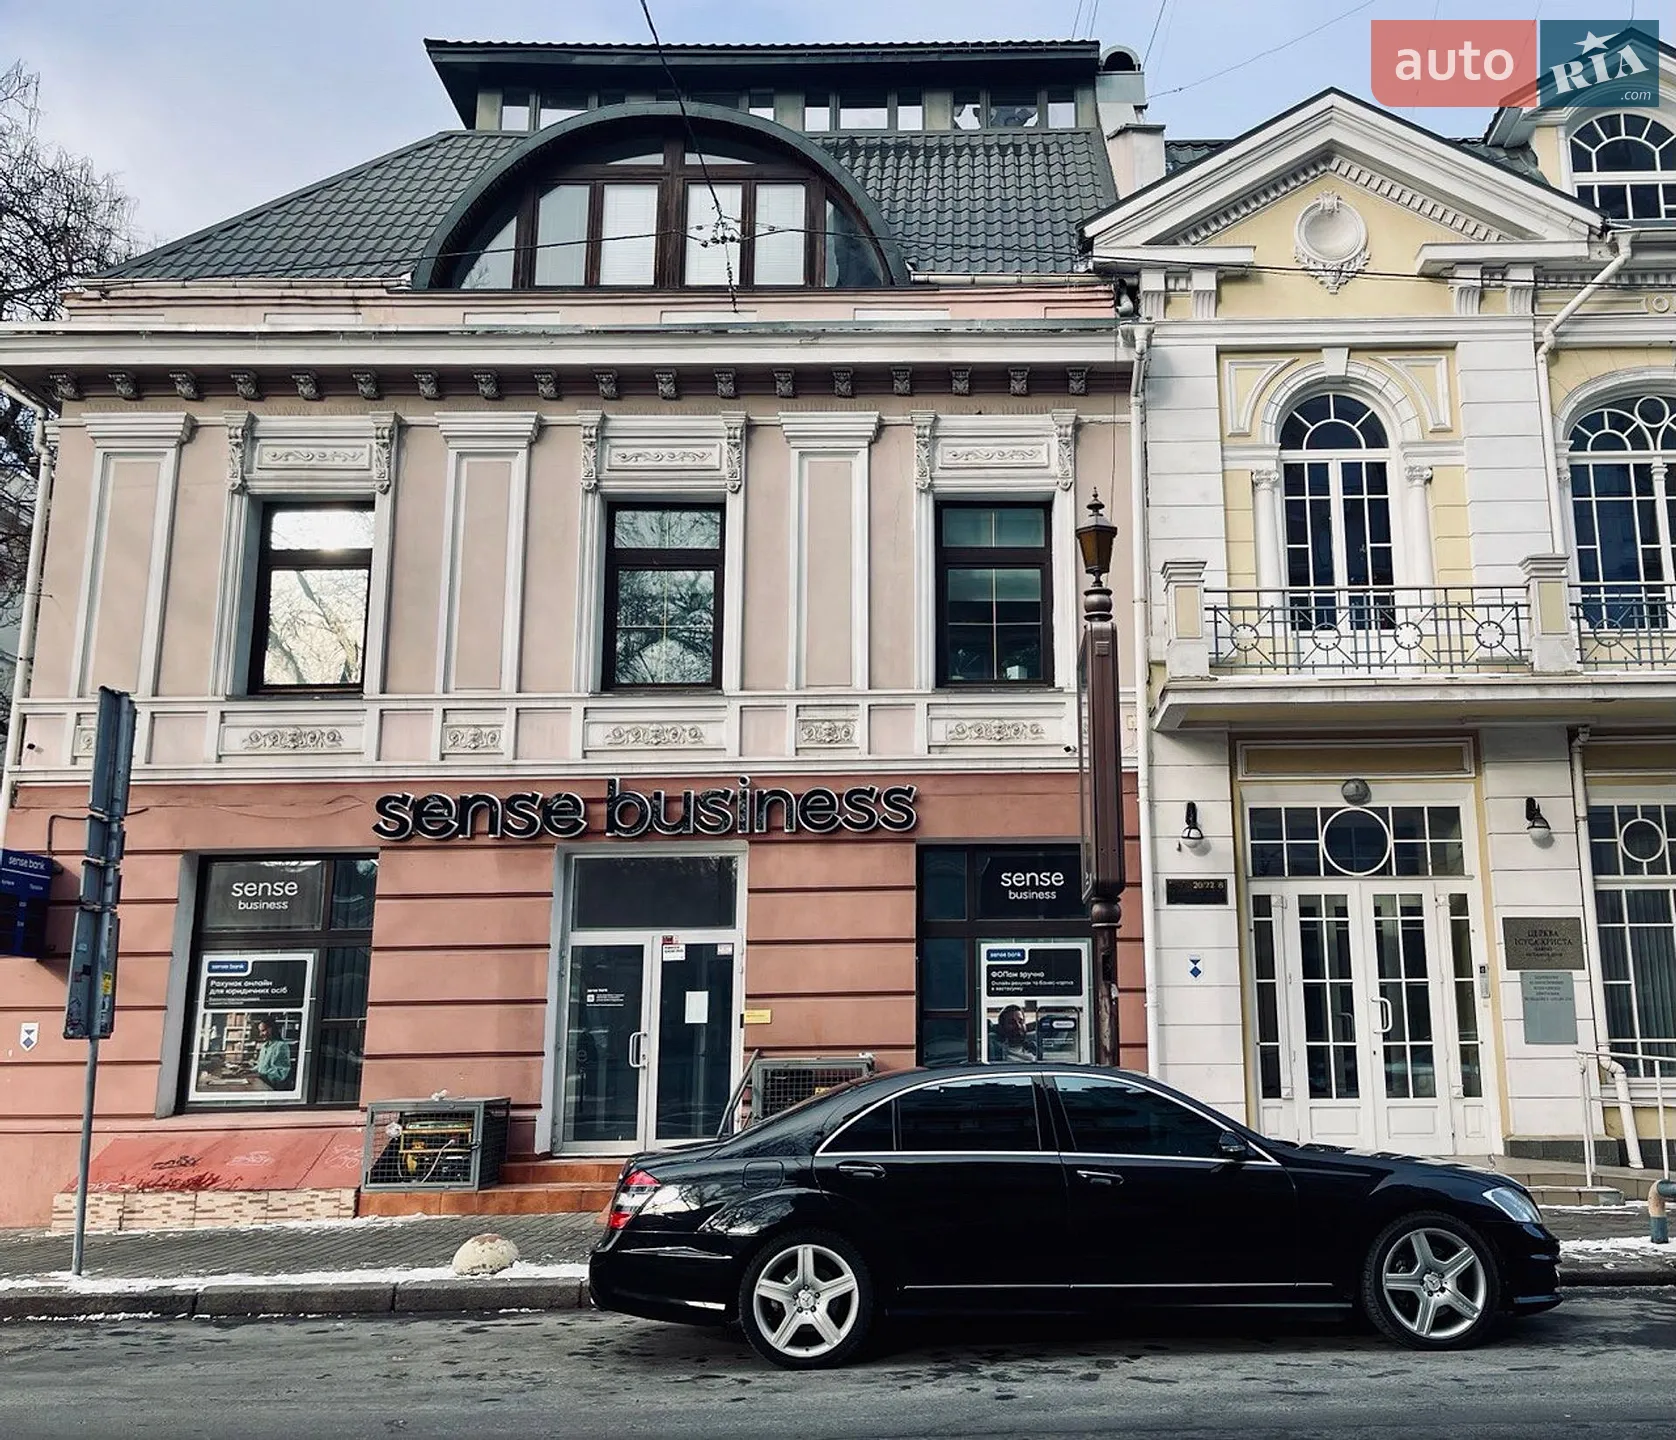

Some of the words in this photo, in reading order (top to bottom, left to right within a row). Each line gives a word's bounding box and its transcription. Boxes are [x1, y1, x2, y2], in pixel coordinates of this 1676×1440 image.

[372, 791, 587, 842] sense
[606, 776, 918, 837] business
[8, 856, 28, 868] sense
[1000, 872, 1065, 887] sense
[231, 881, 298, 897] sense
[1008, 889, 1057, 900] business
[238, 899, 289, 910] business
